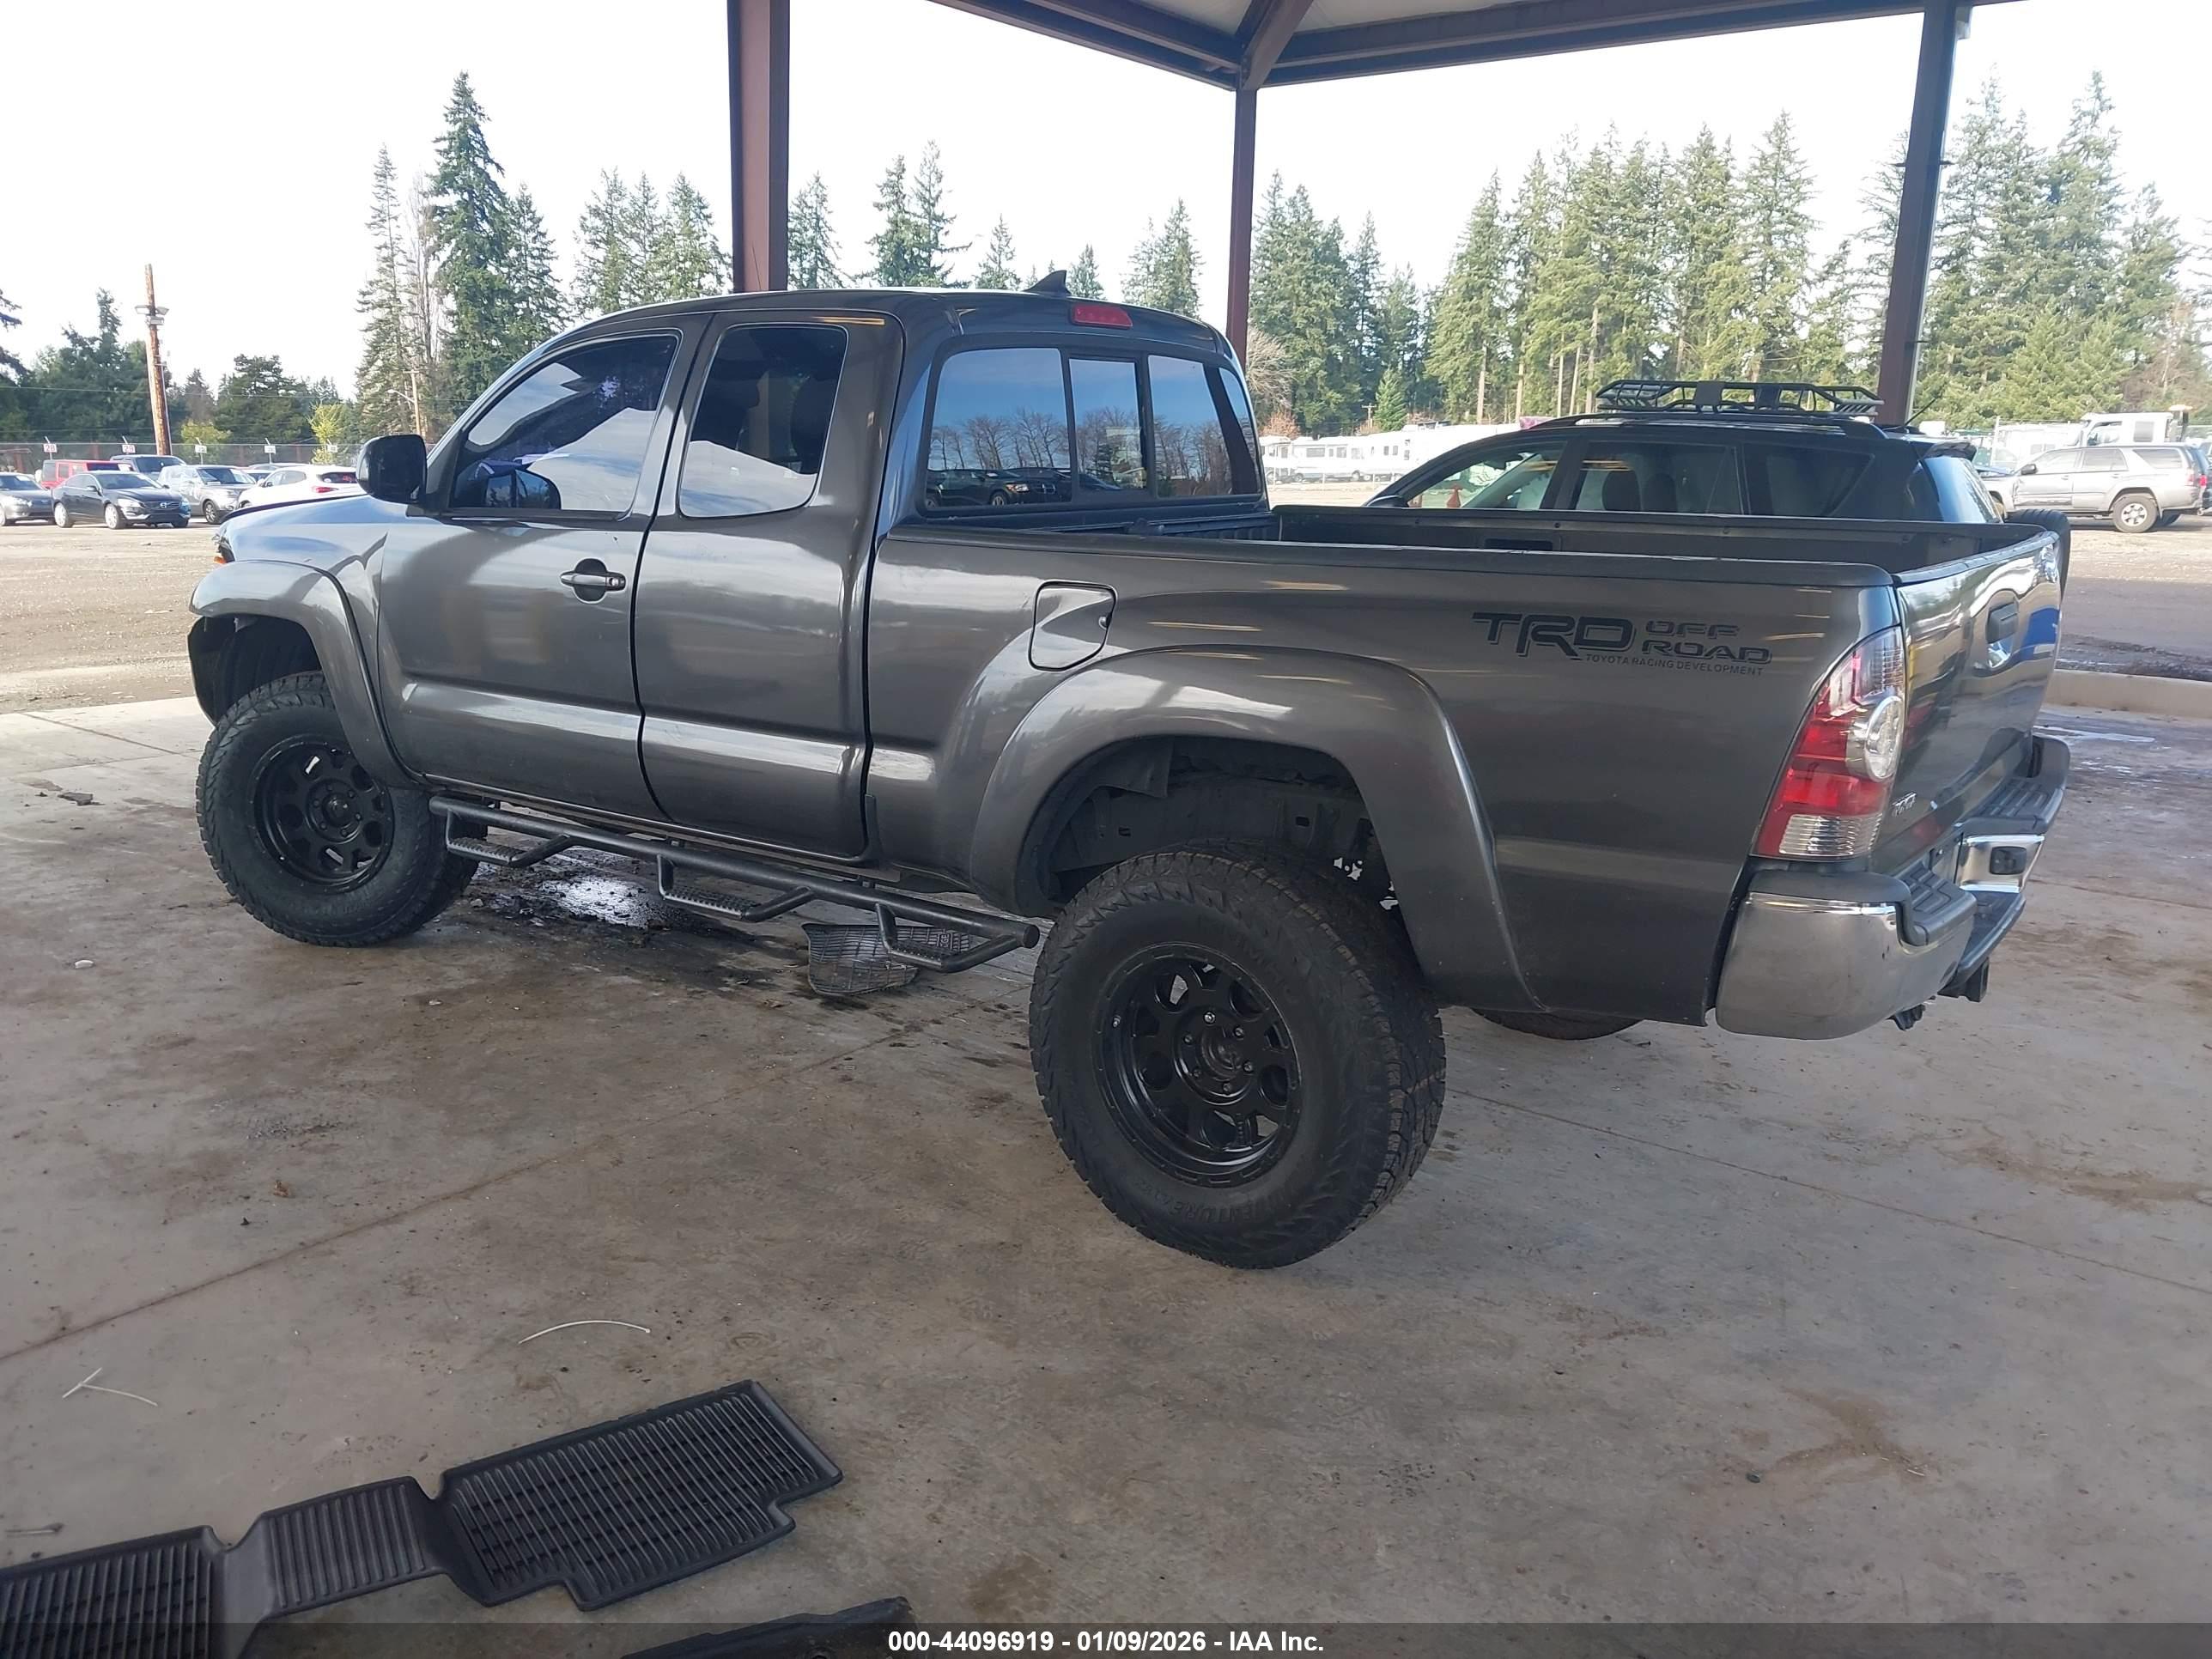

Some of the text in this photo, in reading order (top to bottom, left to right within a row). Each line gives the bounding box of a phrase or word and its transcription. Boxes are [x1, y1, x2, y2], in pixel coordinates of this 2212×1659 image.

[1472, 612, 1637, 660] TRD
[1644, 620, 1740, 640] OFF
[1641, 639, 1773, 665] ROAD
[1585, 653, 1765, 677] TOYOTA RACING DEVELOPMENT
